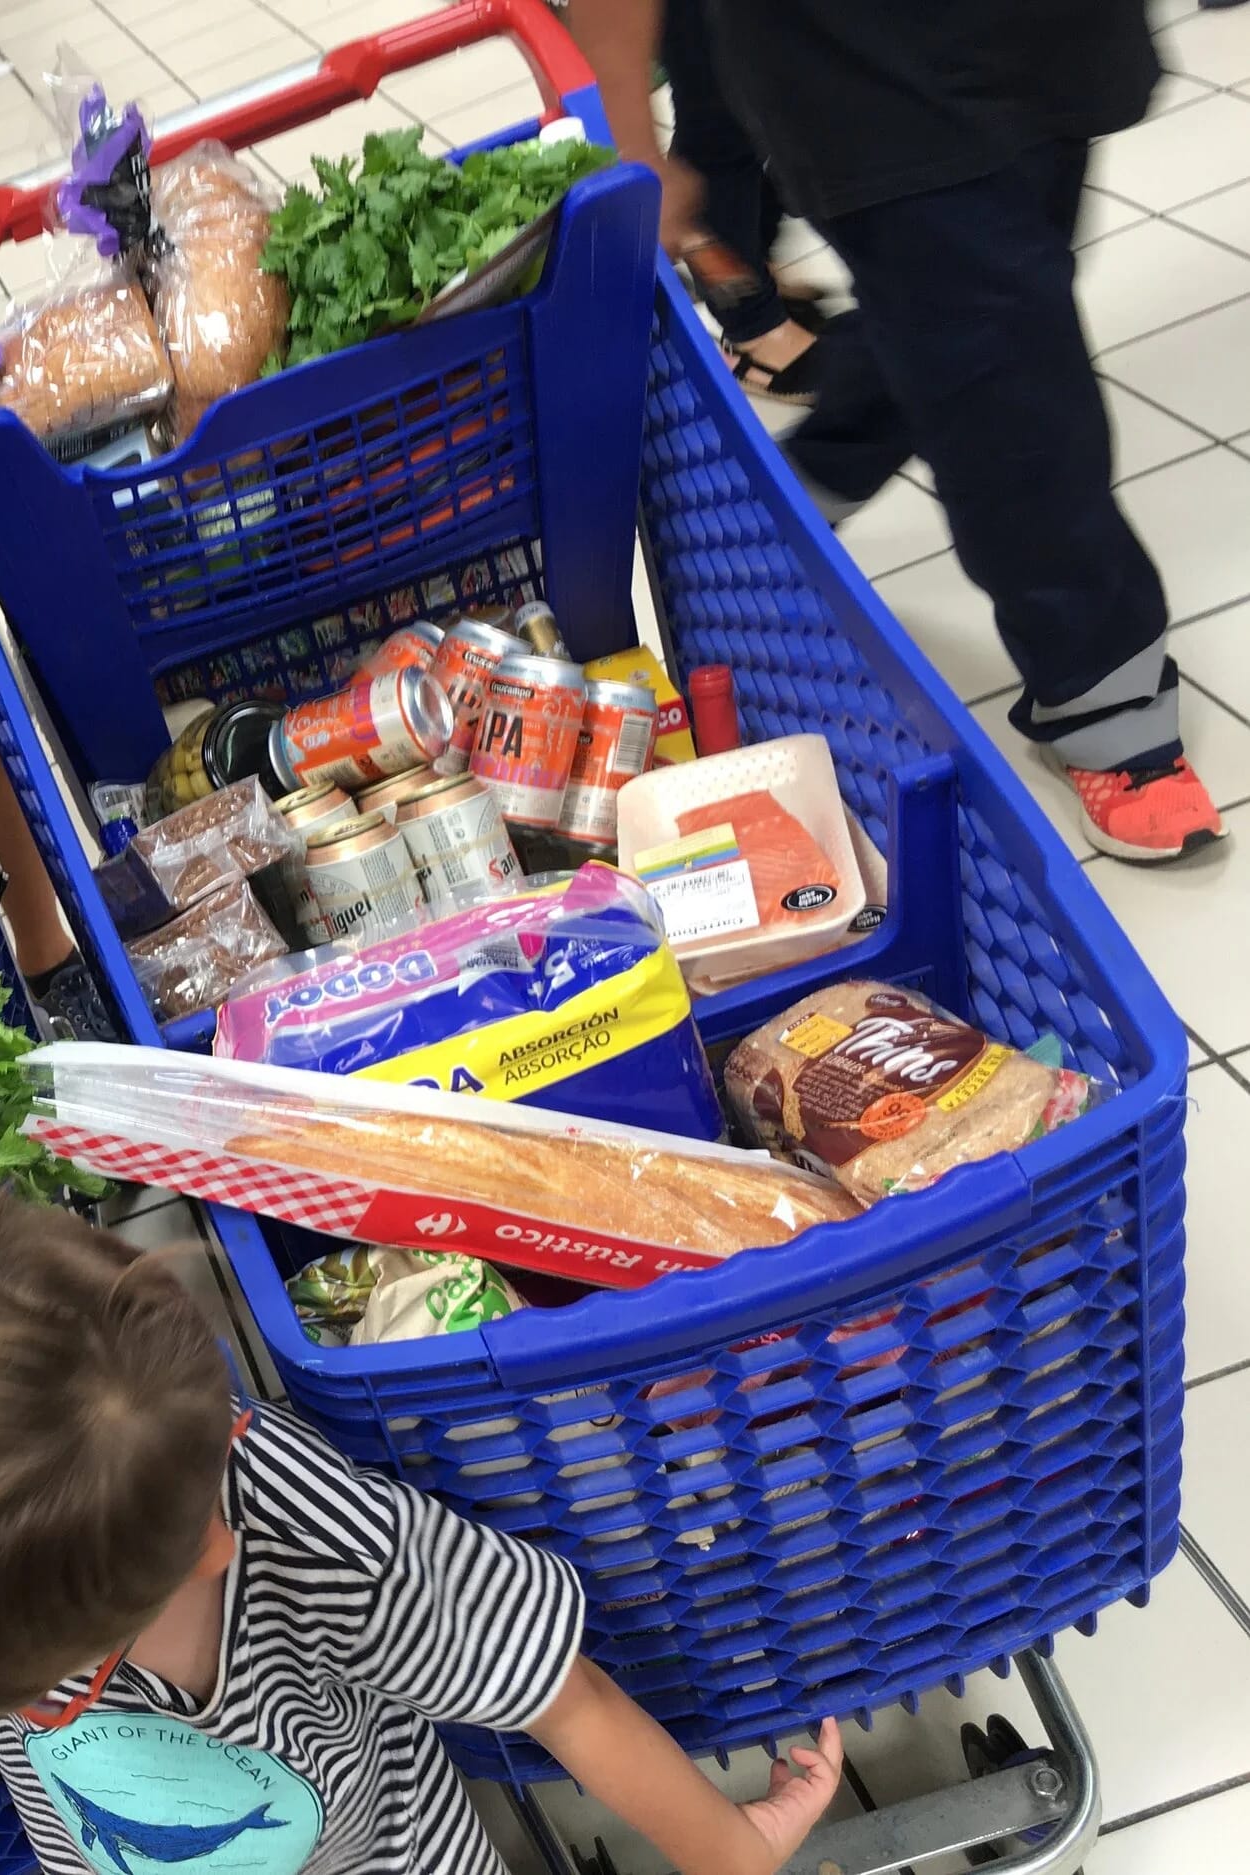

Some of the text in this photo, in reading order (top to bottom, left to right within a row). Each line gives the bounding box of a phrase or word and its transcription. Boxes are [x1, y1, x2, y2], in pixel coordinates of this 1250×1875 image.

[478, 706, 524, 759] IPA
[489, 852, 516, 880] San
[321, 890, 373, 940] Miguel
[264, 949, 438, 1028] DODOT
[499, 1007, 619, 1066] ABSORCIÓN
[505, 1030, 611, 1086] ABSORÇÃO
[835, 1016, 958, 1083] Thins
[495, 1224, 644, 1270] Rústico
[51, 1725, 277, 1791] GIANT OF THE OCEAN
